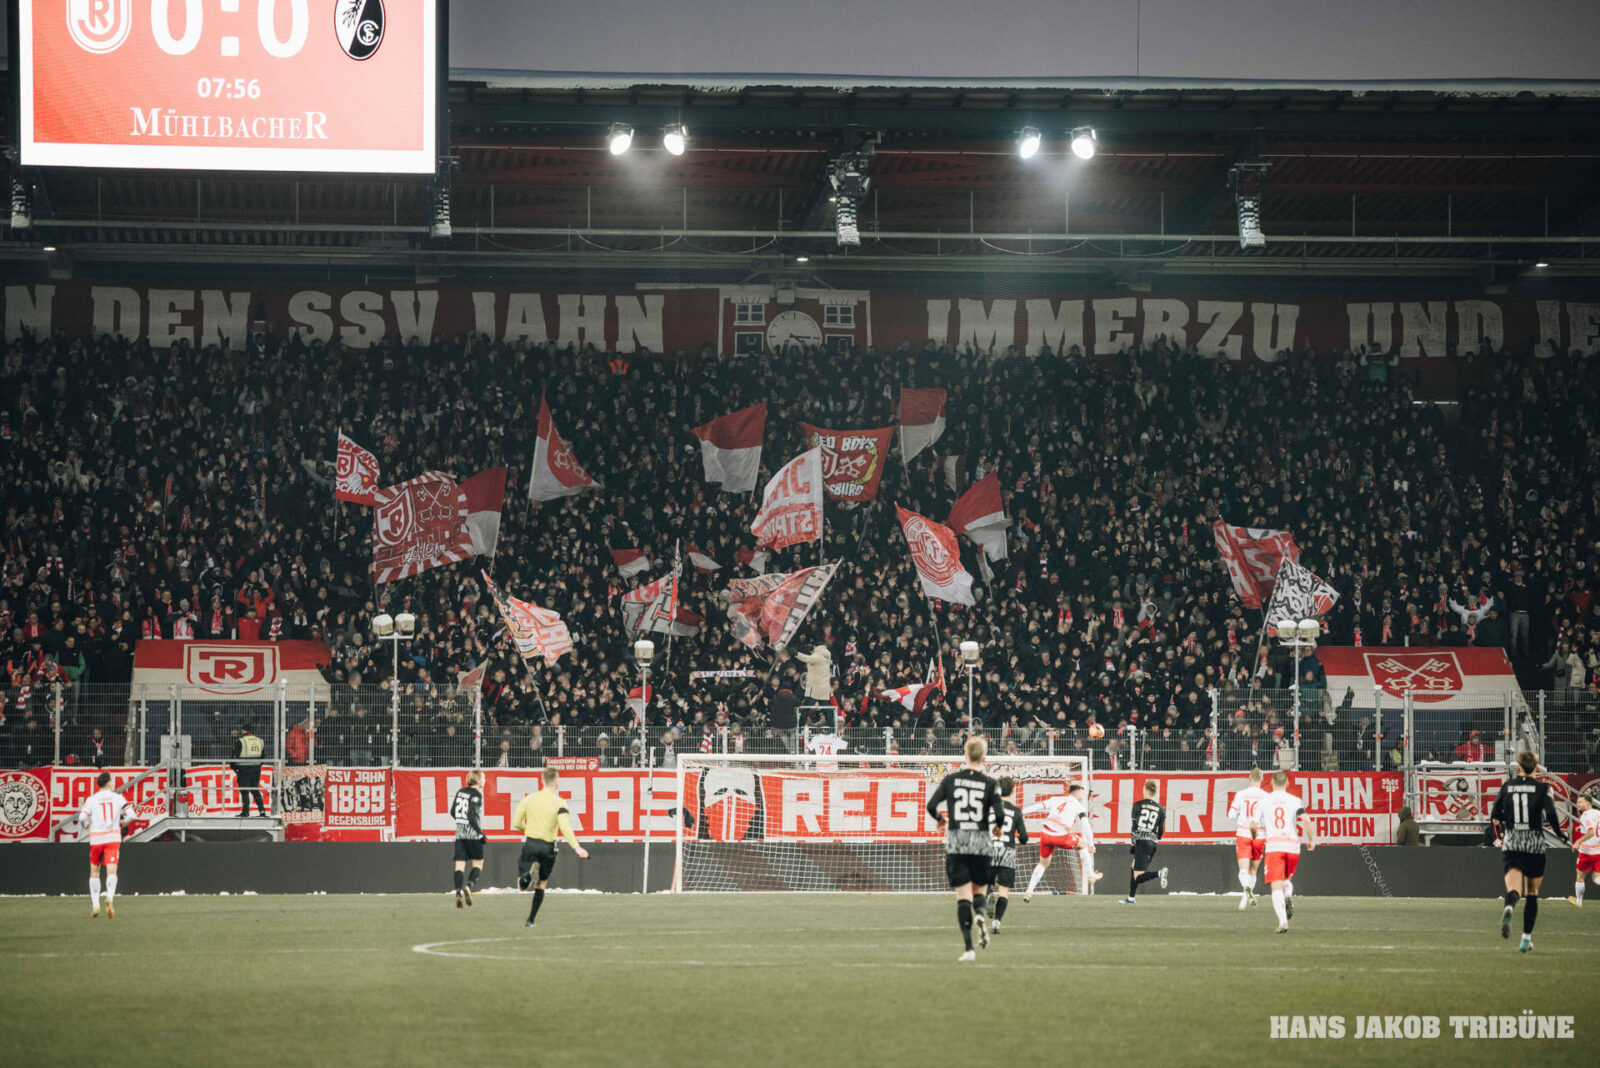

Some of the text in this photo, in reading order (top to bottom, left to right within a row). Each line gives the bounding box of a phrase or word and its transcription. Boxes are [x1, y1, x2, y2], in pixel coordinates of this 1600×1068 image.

[197, 77, 261, 100] 07:56
[130, 107, 329, 140] MÜHLBACHER
[91, 286, 251, 350] DEN
[288, 290, 439, 349] SSV
[927, 298, 1300, 362] IMMERZU
[1347, 300, 1503, 357] UND
[328, 770, 351, 782] SSV
[354, 771, 386, 783] JAHN
[328, 784, 386, 814] 1889
[1296, 776, 1373, 811] JAHN
[100, 802, 114, 823] 11
[455, 797, 470, 820] 28
[954, 788, 985, 823] 25
[1057, 802, 1067, 814] 4
[1512, 792, 1530, 823] 11
[328, 815, 386, 826] REGENSBURG
[1138, 809, 1159, 831] 29
[1275, 807, 1285, 829] 8
[1296, 816, 1375, 838] STADION
